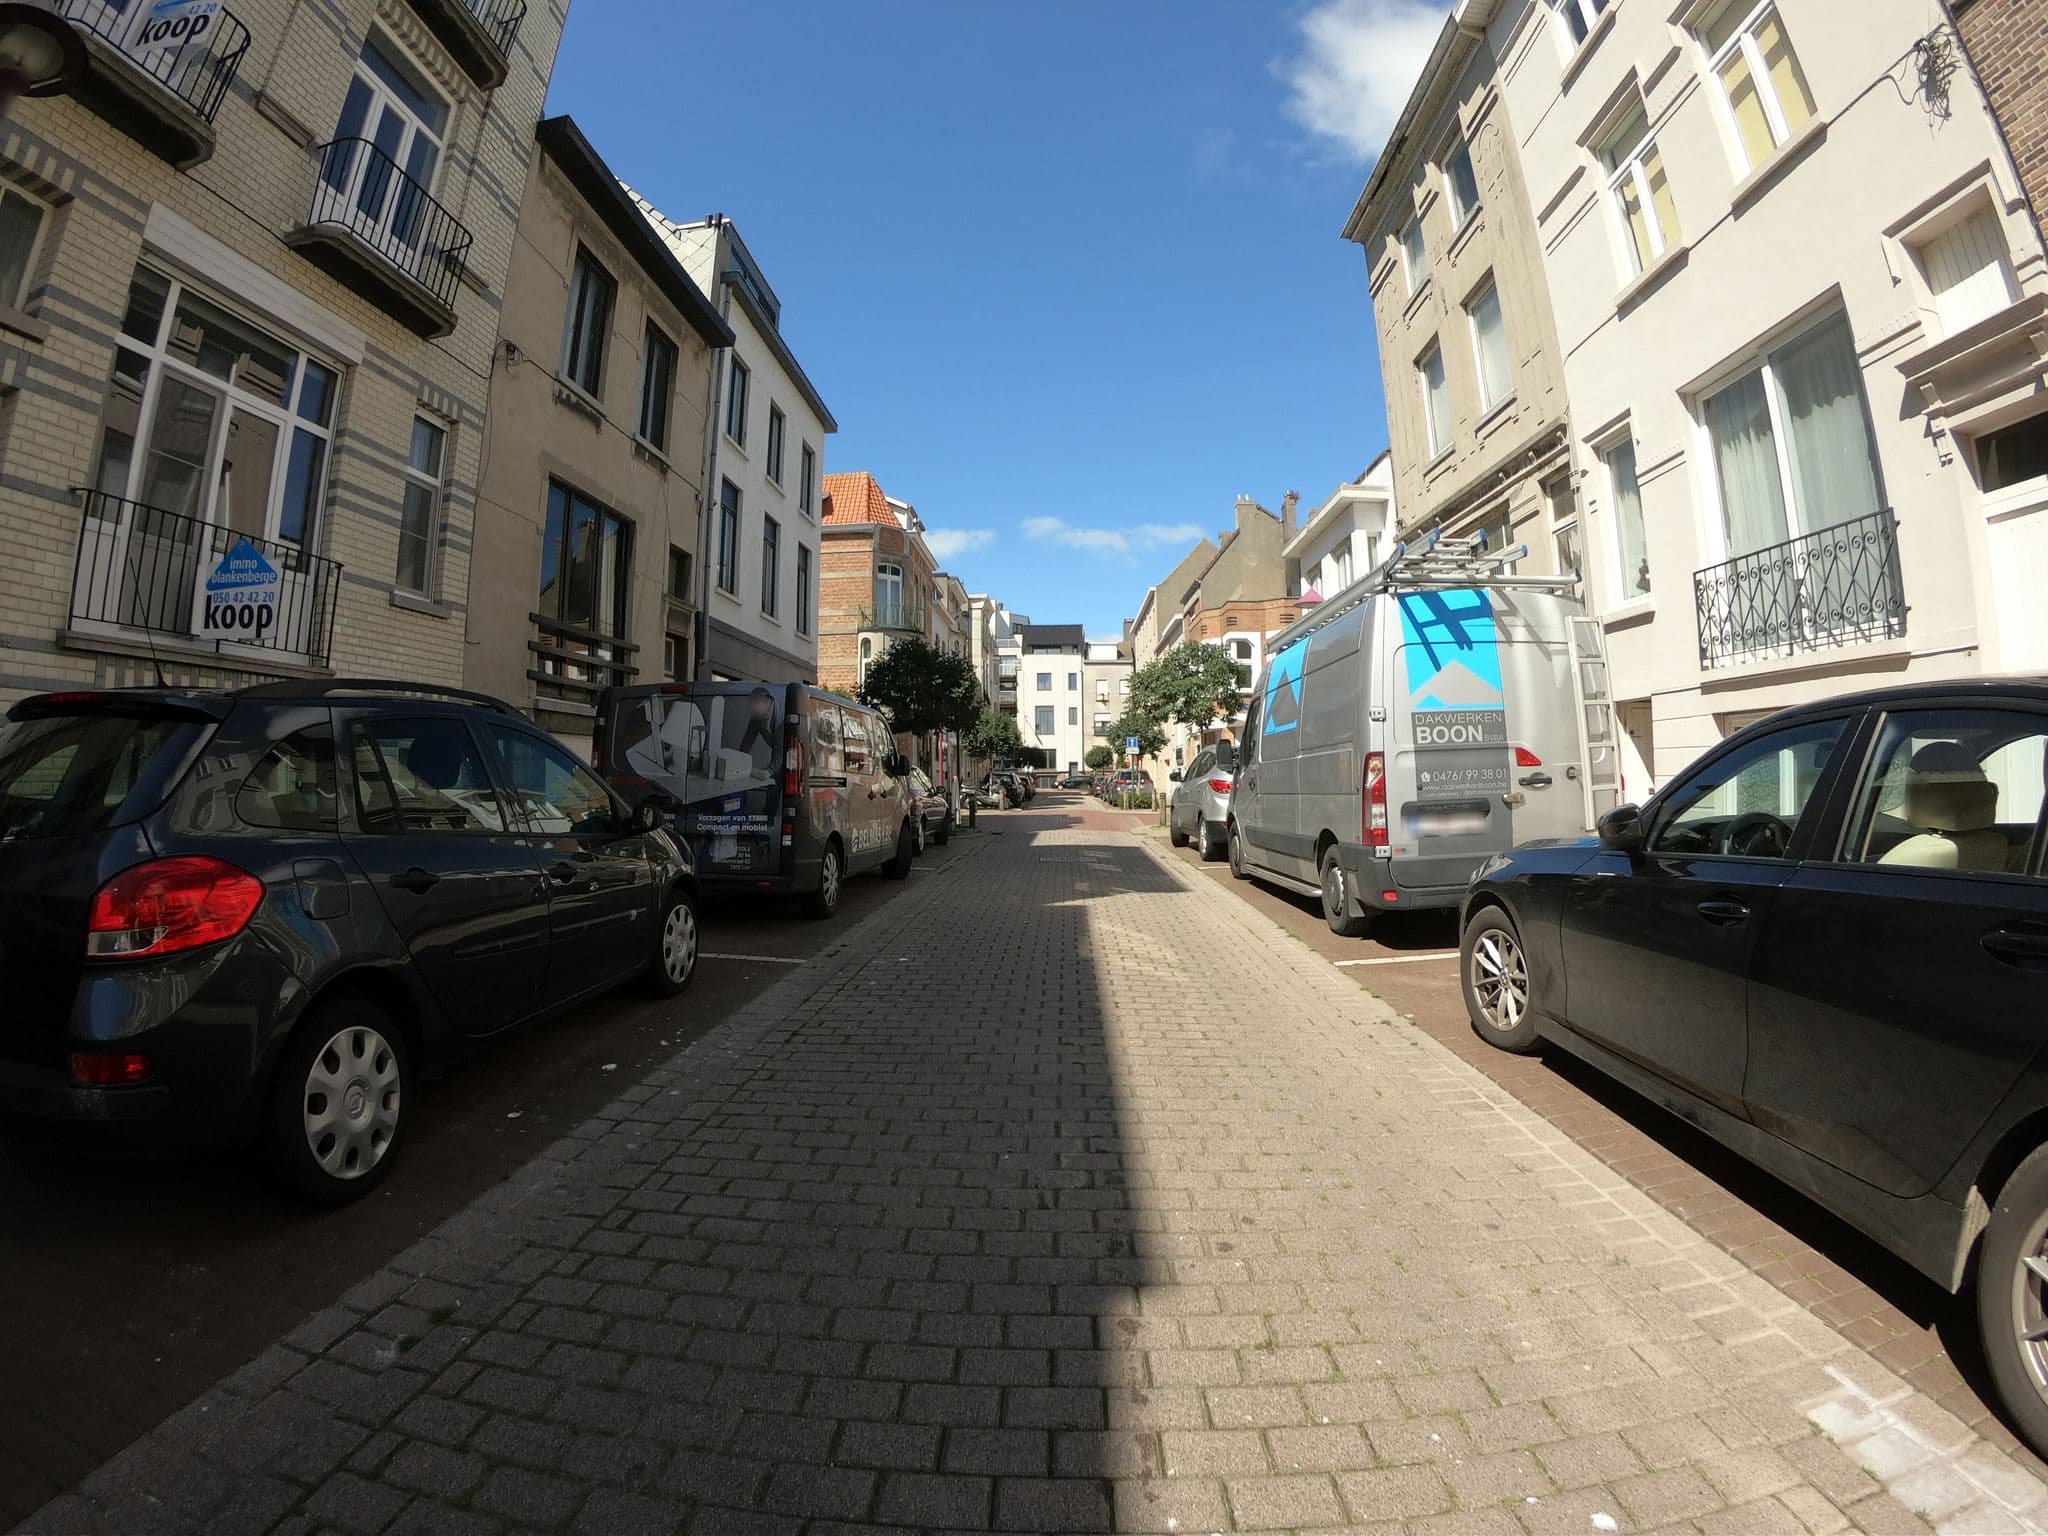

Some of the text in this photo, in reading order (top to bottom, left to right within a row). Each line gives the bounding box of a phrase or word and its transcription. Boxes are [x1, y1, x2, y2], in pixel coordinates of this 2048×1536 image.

[136, 14, 210, 46] koop
[229, 557, 258, 570] immo
[213, 591, 275, 603] 050 42 42 20
[203, 594, 273, 638] koop
[1415, 712, 1502, 725] DAKWERKEN
[1416, 725, 1504, 744] BOON BVBA
[1433, 768, 1507, 782] 0476/ 99 38 01
